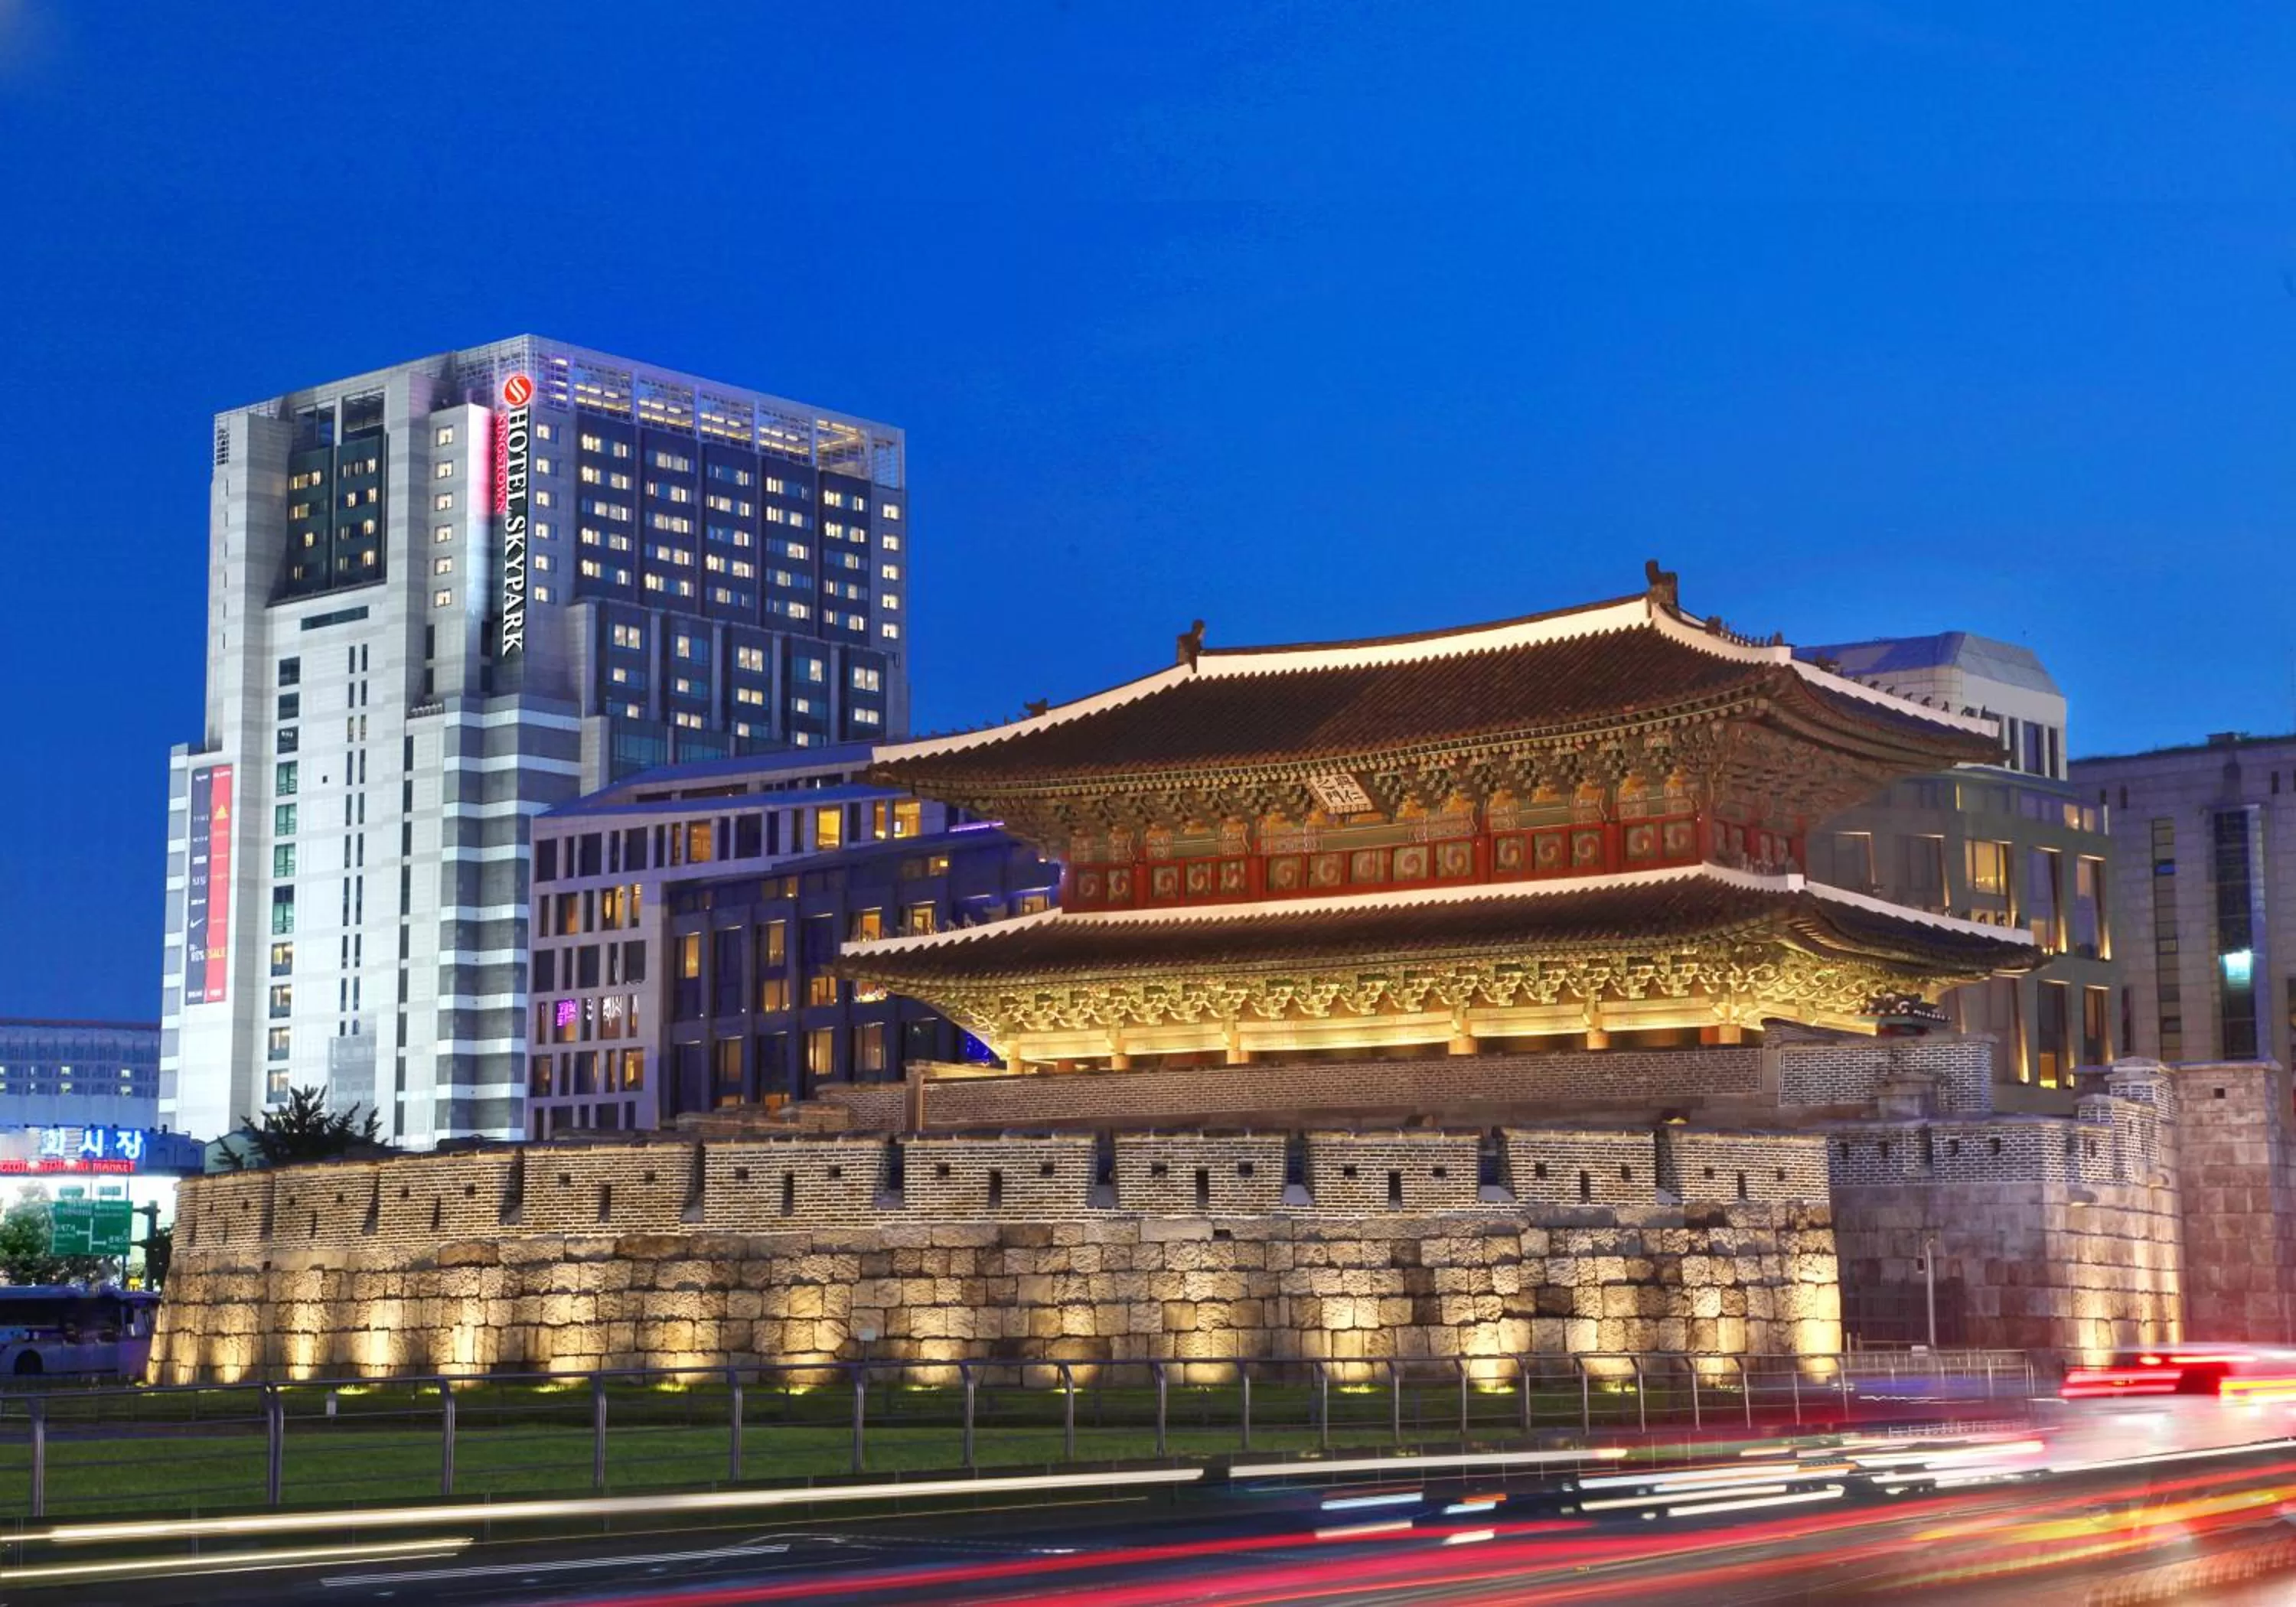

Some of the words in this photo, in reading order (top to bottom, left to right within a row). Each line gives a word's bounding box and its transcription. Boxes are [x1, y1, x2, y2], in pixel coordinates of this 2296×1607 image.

[497, 412, 507, 514] KINGSTOWN
[507, 407, 527, 510] HOTEL
[502, 516, 526, 657] SKYPARK
[93, 1160, 136, 1173] MARKET
